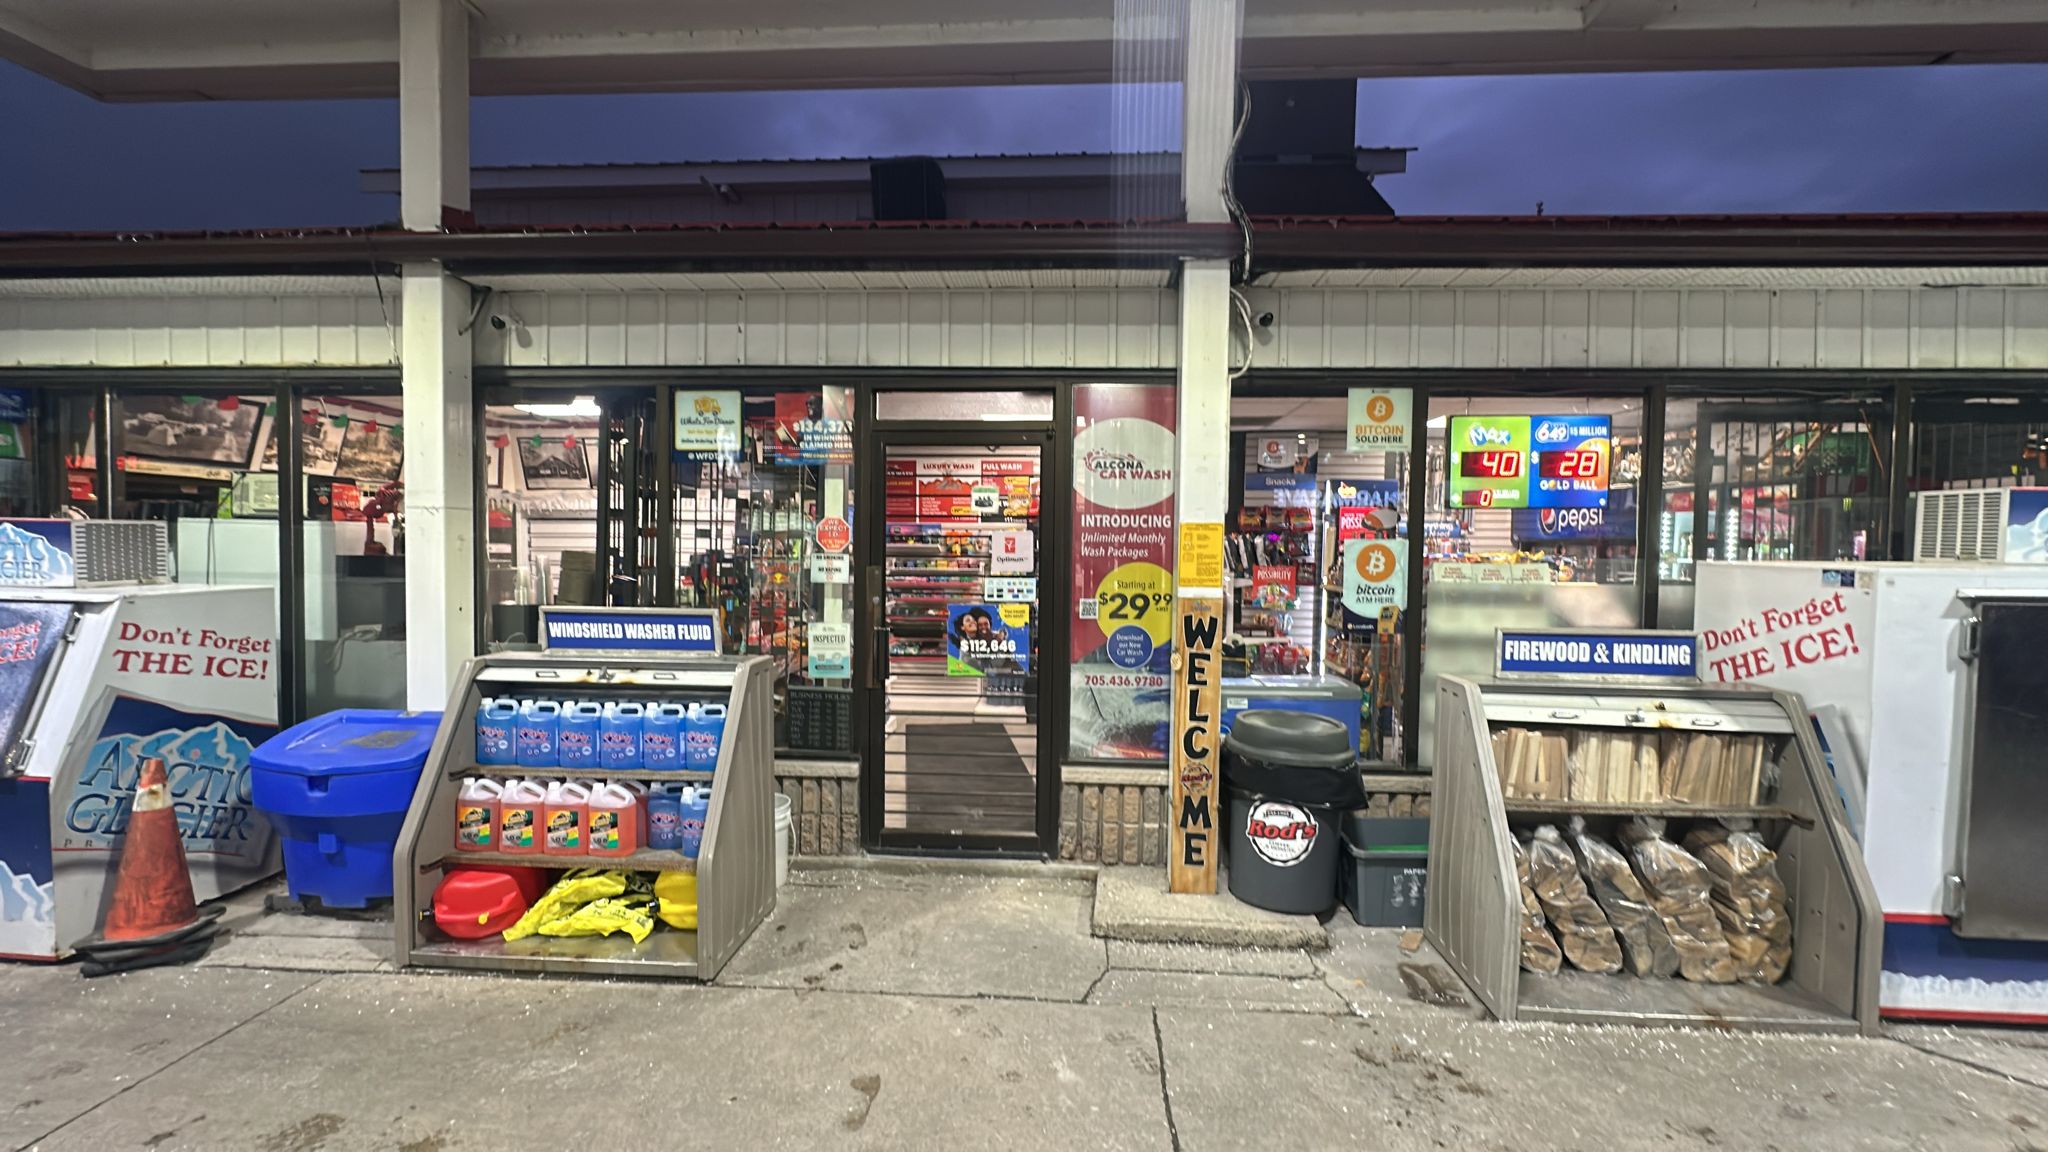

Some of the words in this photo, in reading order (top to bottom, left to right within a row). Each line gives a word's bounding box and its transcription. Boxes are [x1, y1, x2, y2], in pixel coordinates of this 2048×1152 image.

[1355, 425, 1404, 435] BITCOIN
[1578, 426, 1607, 436] MILLION
[1355, 435, 1379, 444] SOLD
[1380, 435, 1404, 444] HERE
[983, 463, 999, 471] FULL
[1000, 463, 1022, 471] WASH
[1094, 461, 1144, 470] ALCONA
[1482, 452, 1518, 476] 40
[1559, 452, 1597, 476] 28
[1100, 470, 1127, 480] CAR
[1130, 470, 1172, 481] WASH
[1265, 476, 1296, 486] Snacks
[1573, 480, 1597, 490] BALL
[1081, 514, 1172, 528] INTRODUCING
[1558, 508, 1603, 532] pepsi
[1081, 532, 1126, 543] Unlimited
[1128, 533, 1166, 545] Monthly
[1081, 546, 1105, 557] Wash
[1107, 547, 1149, 560] Packages
[996, 556, 1024, 564] Optimum
[0, 561, 47, 579] CIER
[1117, 580, 1146, 591] Starting
[1147, 580, 1156, 589] at
[1356, 584, 1395, 596] bitcoin
[1356, 596, 1373, 604] ATM
[1374, 596, 1394, 604] HERE
[1702, 618, 1759, 652] Don't
[1761, 591, 1847, 634] Forget
[118, 621, 193, 646] Don't
[198, 629, 272, 655] Forget
[549, 622, 623, 640] WINDSHIELD
[624, 623, 677, 641] WASHER
[677, 624, 712, 641] FLUID
[813, 634, 846, 643] INSPECTED
[1504, 640, 1590, 663] FIREWOOD
[1593, 642, 1610, 664] &
[1612, 643, 1691, 666] KINDLING
[1709, 646, 1775, 683] THE
[1780, 622, 1860, 670] ICE!
[112, 649, 193, 675] THE
[203, 656, 269, 681] ICE!
[1084, 675, 1163, 687] 705.436.9780
[65, 792, 248, 842] GLCIER
[1248, 816, 1317, 840] Rod's
